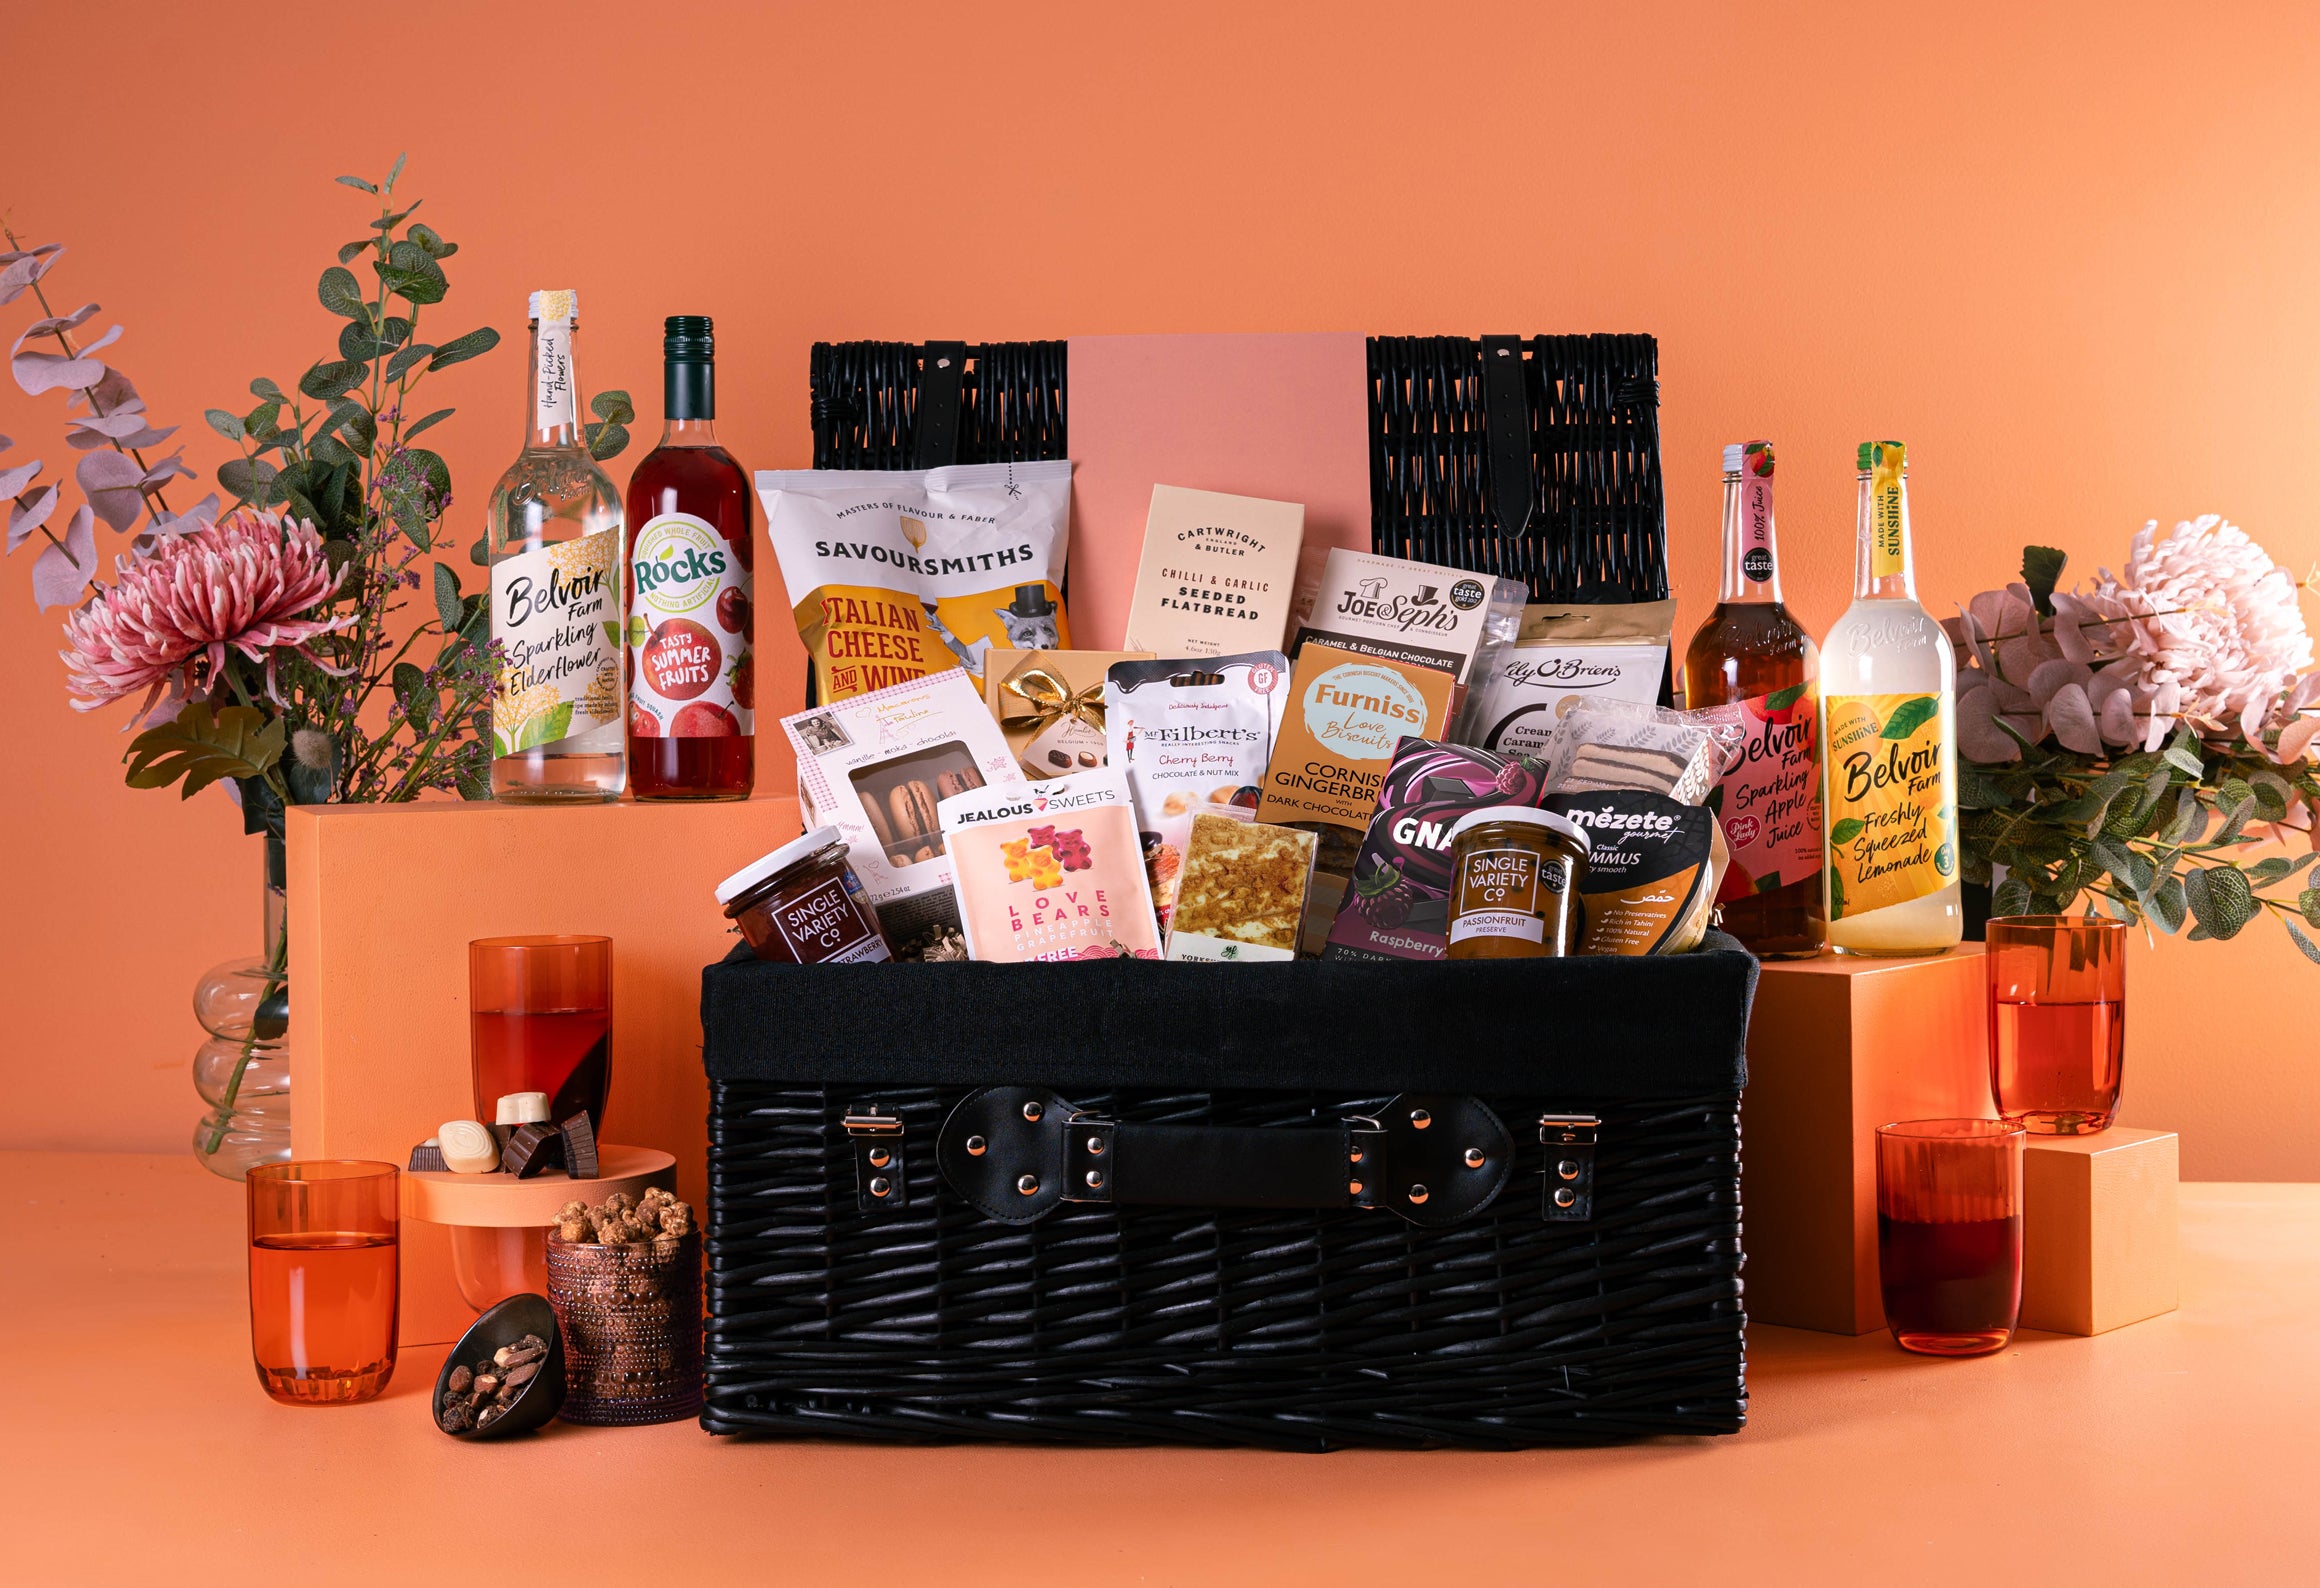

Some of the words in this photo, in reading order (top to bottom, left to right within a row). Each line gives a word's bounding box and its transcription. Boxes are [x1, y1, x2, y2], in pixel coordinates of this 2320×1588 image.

[543, 338, 555, 408] Hand-Picked
[555, 354, 566, 391] Flowers
[1752, 486, 1765, 512] Juice
[836, 502, 879, 519] MASTERS
[882, 502, 894, 510] OF
[897, 504, 944, 519] FLAVOUR
[961, 514, 997, 524] FABER
[664, 527, 691, 536] WHOLE
[692, 532, 711, 550] FRUIT
[1177, 526, 1266, 553] CARTWRIGHT
[1754, 513, 1765, 542] 100%
[815, 541, 1034, 576] SAVOURSMITHS
[1205, 545, 1245, 556] BUTLER
[1751, 554, 1767, 562] great
[634, 547, 727, 595] Rocks
[1745, 561, 1774, 571] taste
[650, 592, 681, 608] NOTHING
[682, 577, 716, 608] ARTIFICIAL
[1161, 568, 1204, 583] CHILLI
[1211, 575, 1218, 585] &
[1224, 577, 1270, 593] GARLIC
[1454, 587, 1481, 599] taste
[506, 566, 604, 628] Belvoir
[1178, 586, 1246, 605] SEEDED
[568, 598, 602, 622] Farm
[821, 597, 920, 643] ITALIAN
[1160, 597, 1260, 621] FLATBREAD
[1337, 591, 1378, 618] JOE
[1376, 595, 1458, 632] Seph's
[1338, 615, 1362, 623] GOURMET
[1362, 619, 1386, 627] POPCORN
[513, 622, 597, 669] Sparkling
[660, 632, 693, 650] TASTY
[827, 630, 925, 663] CHEESE
[1305, 636, 1348, 650] CARAMEL
[1349, 642, 1357, 651] &
[1360, 644, 1400, 659] BELGIAN
[1400, 651, 1455, 669] CHOCOLATE
[651, 646, 712, 672] SUMMER
[510, 648, 601, 696] Elderflower
[658, 664, 710, 692] FRUITS
[832, 667, 857, 692] AND
[1258, 672, 1268, 684] GF
[1315, 684, 1421, 724] Furniss
[1159, 726, 1257, 740] Filbert's
[1343, 711, 1385, 733] Love
[1833, 722, 1848, 736] MADE
[1849, 716, 1867, 726] WITH
[1321, 721, 1394, 750] Biscuits
[884, 744, 908, 756] moka
[1159, 754, 1197, 767] Cherry
[1201, 752, 1233, 767] Berry
[1781, 746, 1811, 770] Farm
[1152, 769, 1198, 780] CHOCOLATE
[1206, 769, 1224, 777] NUT
[1224, 769, 1239, 777] MIX
[1305, 762, 1385, 788] CORNIS
[1843, 740, 1941, 802] Belvoir
[1908, 771, 1941, 796] Farm
[1049, 790, 1115, 809] SWEETS
[1275, 772, 1381, 803] GINGERBR
[1736, 770, 1809, 810] Sparkling
[957, 803, 1033, 824] JEALOUS
[1267, 794, 1299, 808] DARK
[1765, 790, 1806, 824] Apple
[1731, 818, 1753, 835] Pink
[1864, 802, 1925, 835] Freshly
[1618, 827, 1685, 845] gourmet
[1734, 829, 1756, 842] Lady
[1767, 821, 1804, 849] Juice
[1854, 817, 1927, 864] Squeezed
[1473, 857, 1528, 873] SINGLE
[1589, 851, 1641, 865] MMUS
[1858, 843, 1932, 883] Lemonade
[1943, 855, 1950, 868] 3
[1470, 873, 1528, 888] VARIETY
[1542, 869, 1566, 886] taste
[787, 889, 841, 927] SINGLE
[1009, 890, 1107, 917] LOVE
[1624, 910, 1666, 919] Preservatives
[792, 903, 850, 943] VARIETY
[1011, 905, 1110, 932] BEARS
[1014, 918, 1112, 942] PINEAPPLE
[1463, 916, 1526, 928] PASSIONFRUIT
[1016, 928, 1112, 951] GRAPEFRUIT
[1370, 931, 1444, 958] Raspberry
[1337, 948, 1357, 957] 70%
